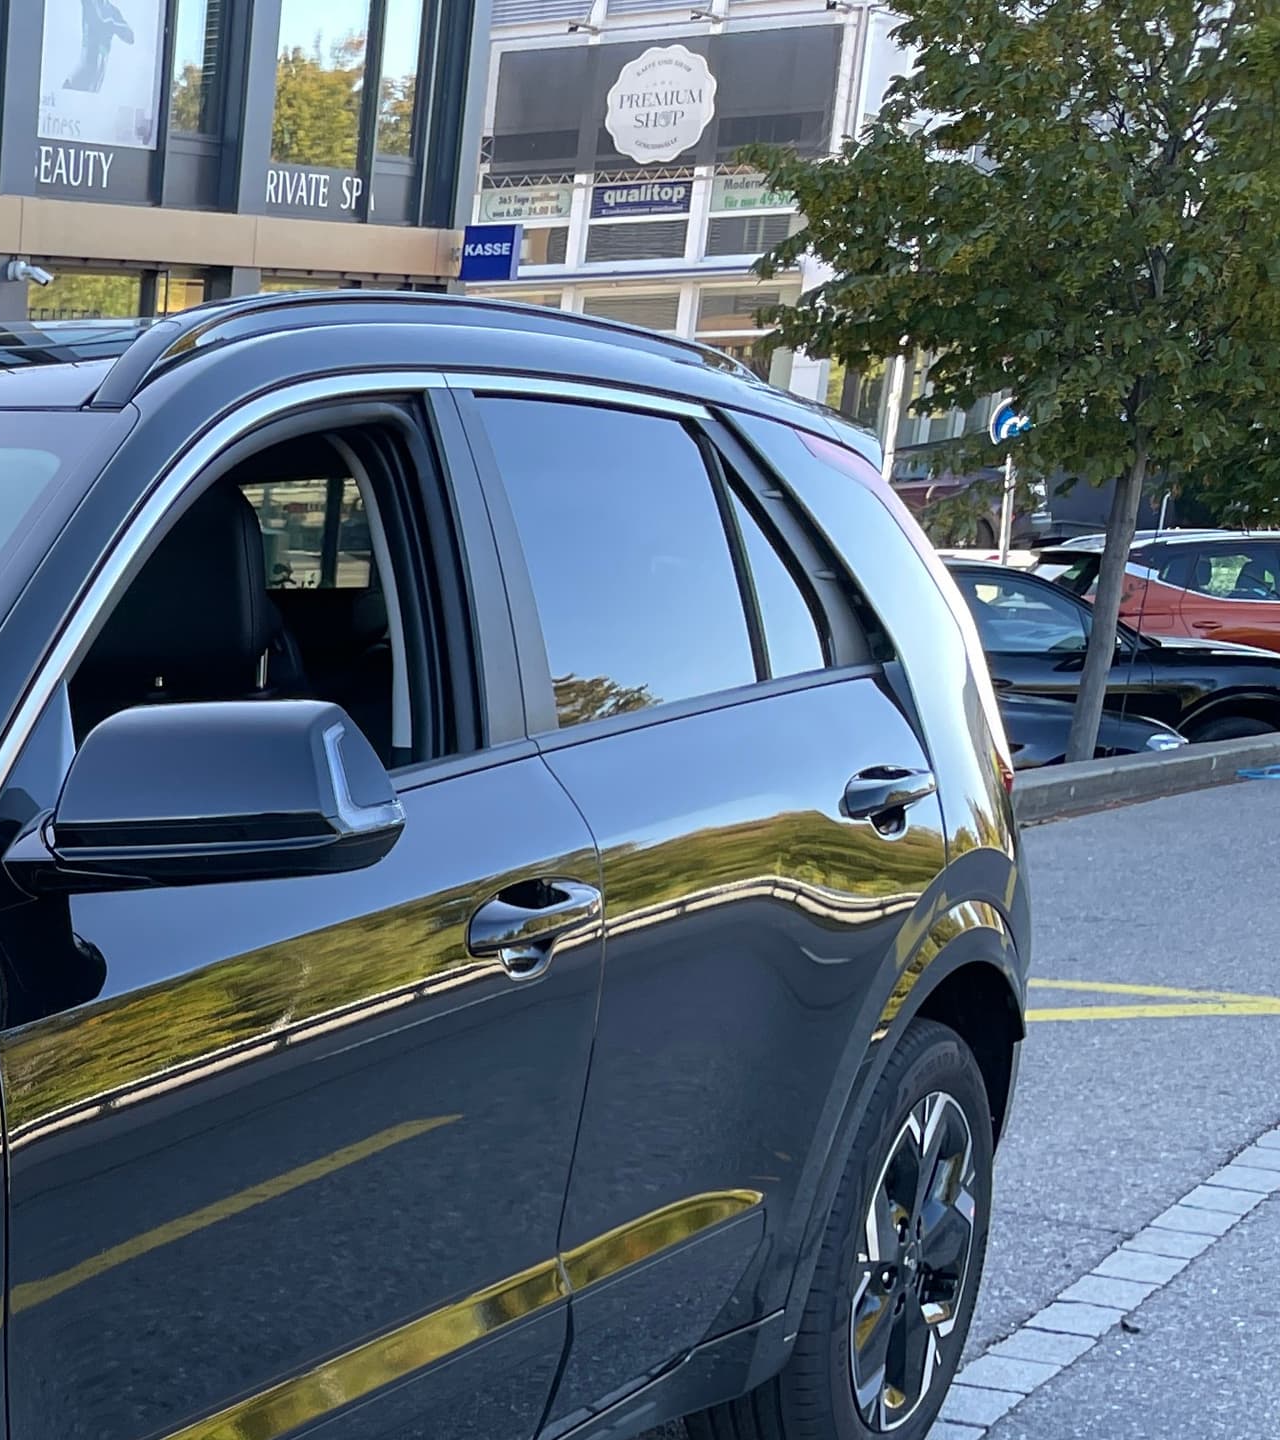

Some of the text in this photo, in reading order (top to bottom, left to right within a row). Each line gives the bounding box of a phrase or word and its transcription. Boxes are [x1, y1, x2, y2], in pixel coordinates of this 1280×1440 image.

[619, 88, 703, 110] PREMIUM
[42, 112, 81, 137] itness
[633, 110, 685, 129] SHOP
[34, 146, 114, 188] EAUTY
[266, 170, 330, 207] RIVATE
[603, 184, 686, 206] qualitop
[464, 242, 512, 257] KASSE
